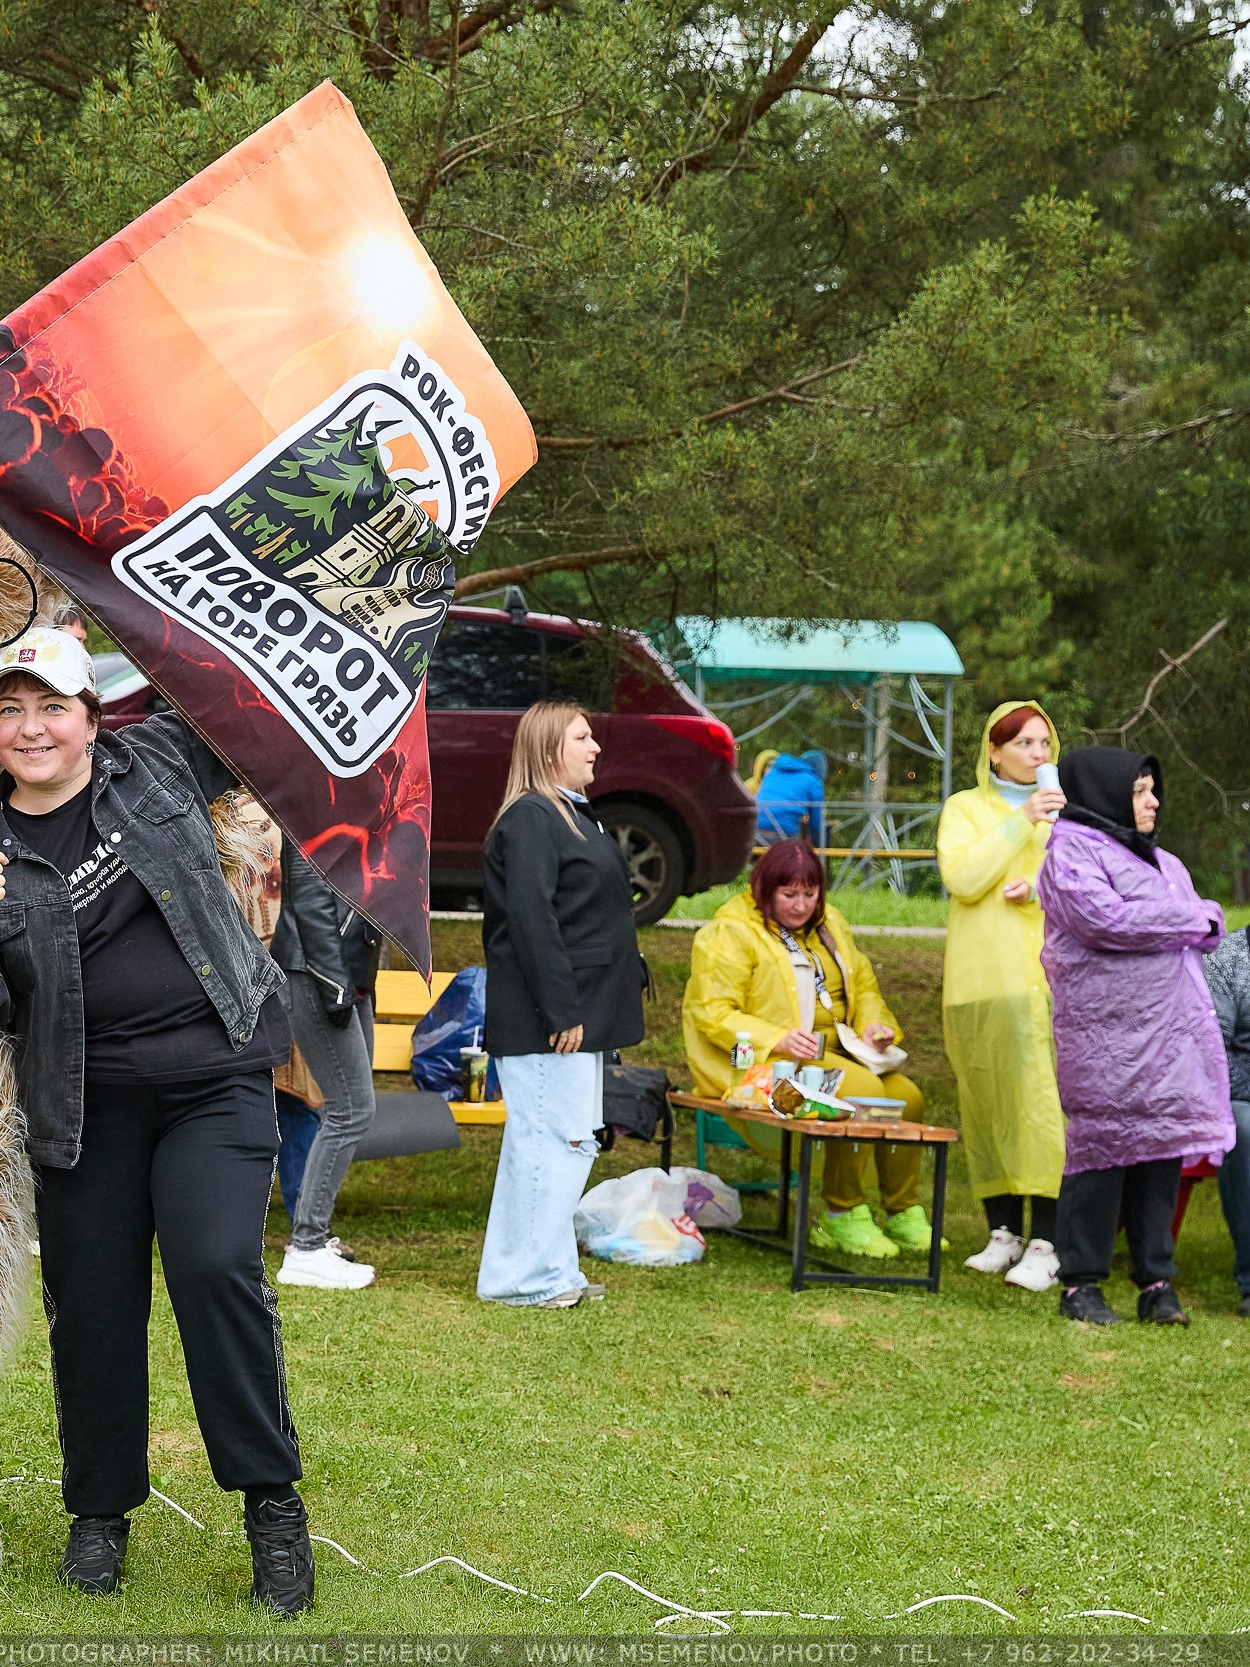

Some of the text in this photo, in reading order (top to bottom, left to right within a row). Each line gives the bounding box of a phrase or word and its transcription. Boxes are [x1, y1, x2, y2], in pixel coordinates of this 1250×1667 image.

[143, 560, 357, 748] НА ГОРЕ ГРЯЗЬ
[174, 532, 400, 714] ПОВОРОТ
